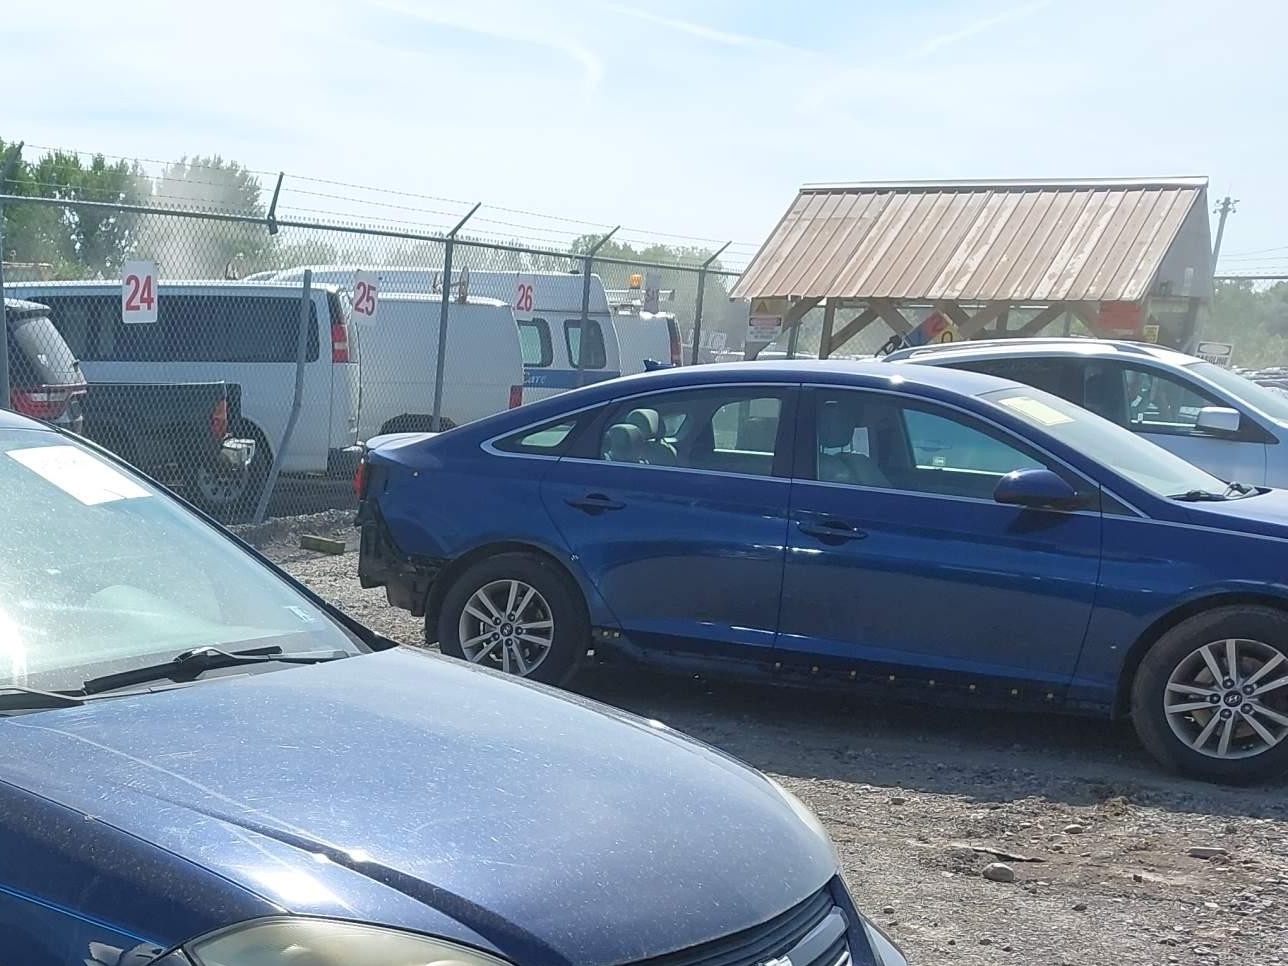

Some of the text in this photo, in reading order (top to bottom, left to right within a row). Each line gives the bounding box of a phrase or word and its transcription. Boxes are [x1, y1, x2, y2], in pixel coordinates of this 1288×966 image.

[125, 274, 155, 312] 24
[354, 281, 377, 316] 25
[516, 284, 533, 312] 26
